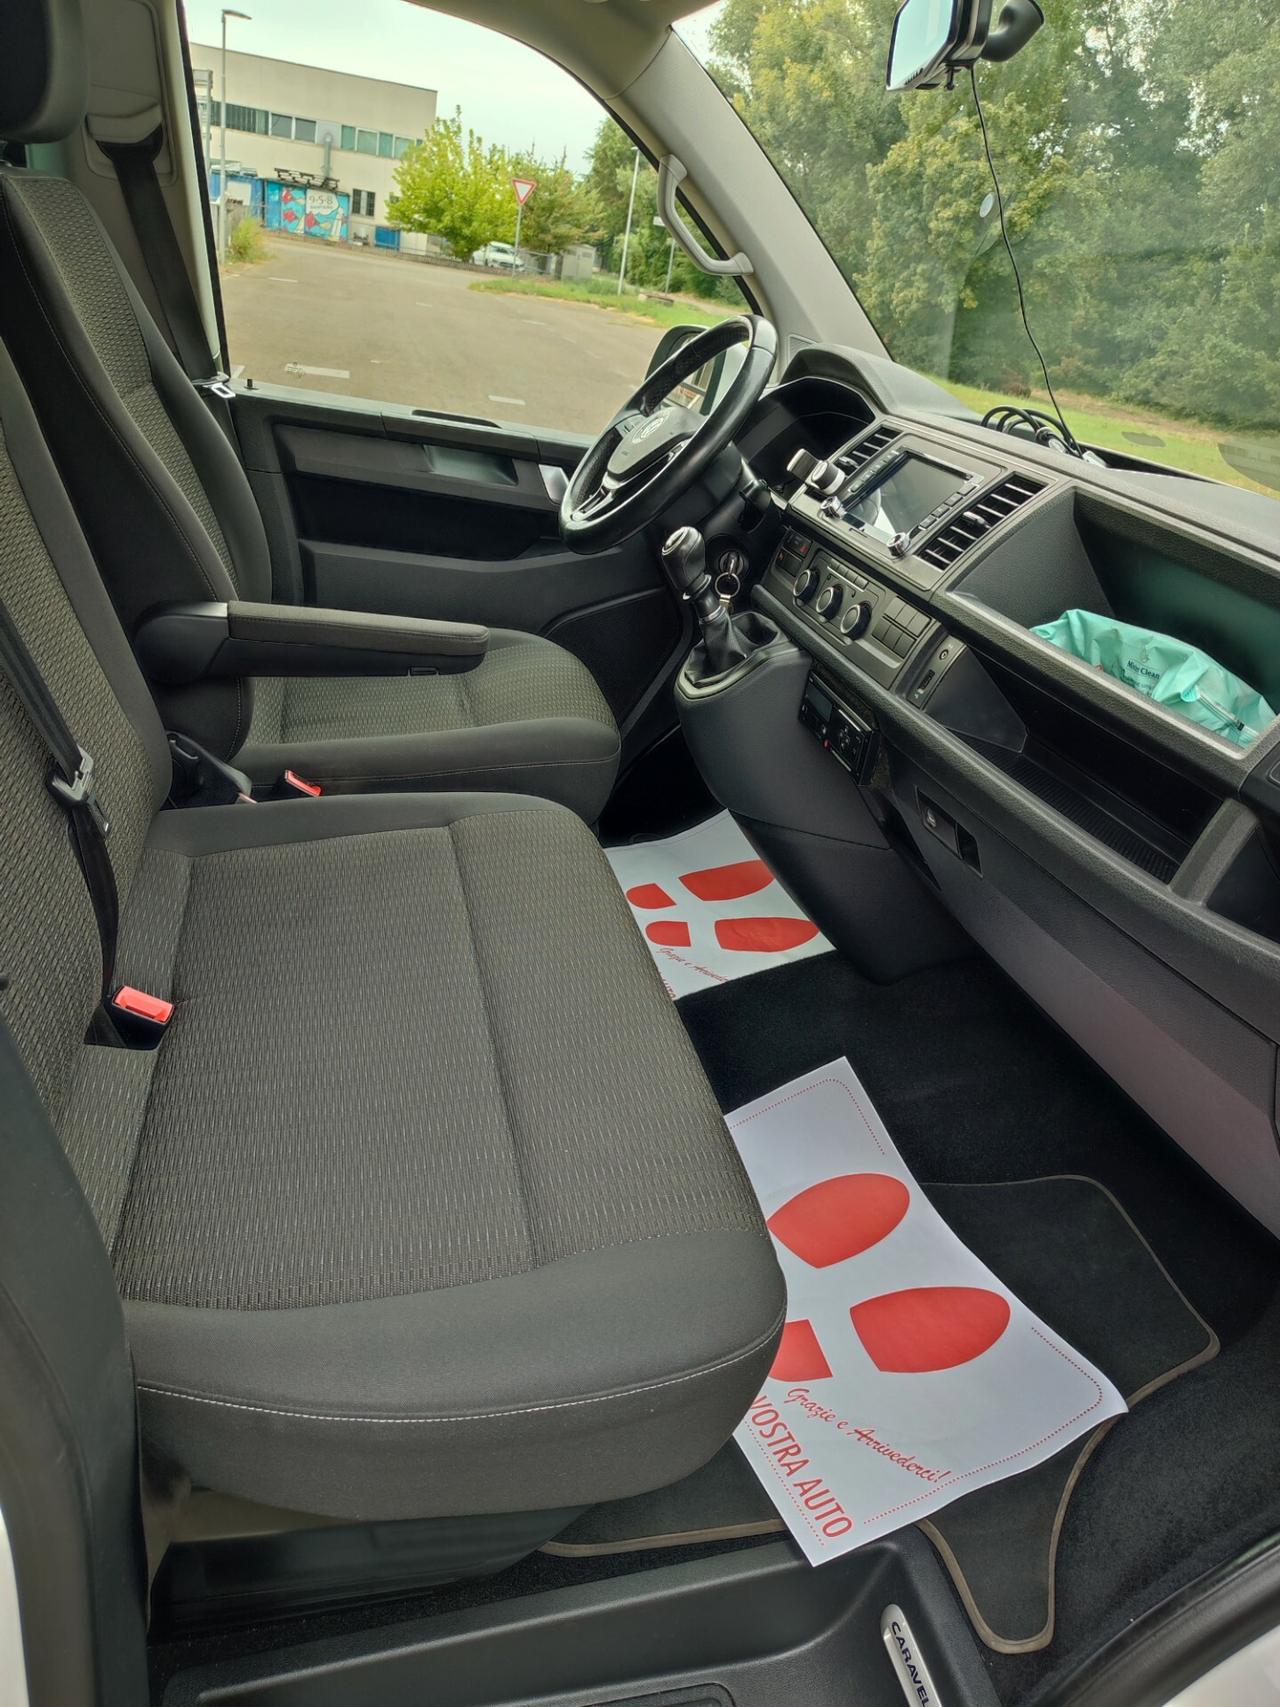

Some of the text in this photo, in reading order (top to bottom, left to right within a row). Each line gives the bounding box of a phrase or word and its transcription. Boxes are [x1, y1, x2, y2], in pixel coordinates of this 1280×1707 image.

[1140, 667, 1160, 680] Clean
[751, 1395, 853, 1538] VOSTRA AUTO
[784, 1387, 951, 1483] Grazie e Arrivederci!
